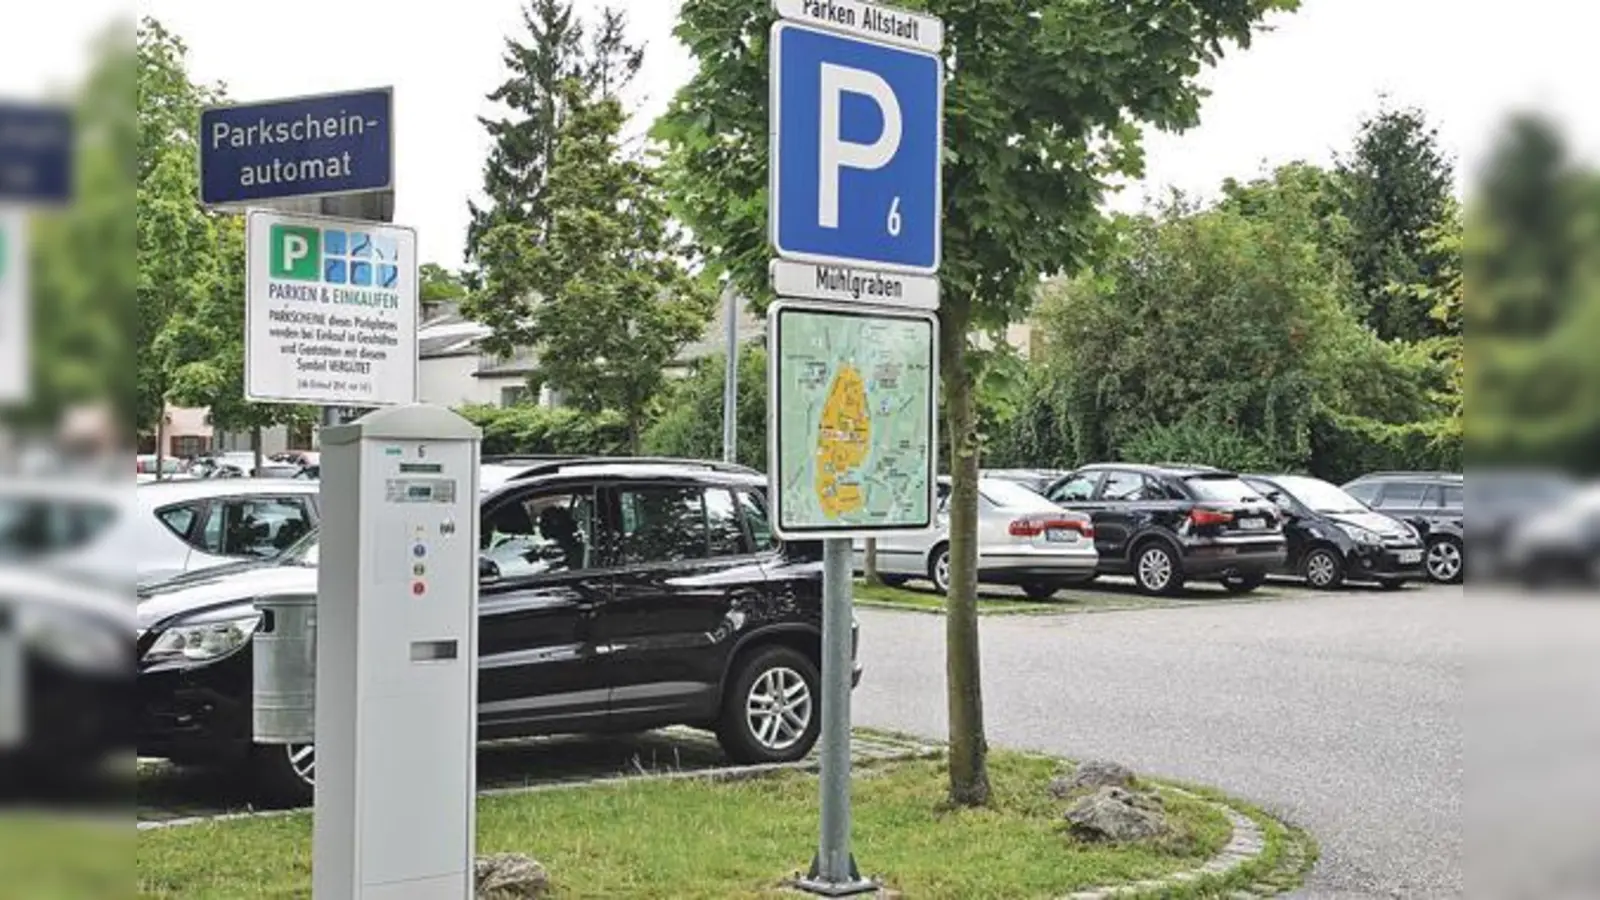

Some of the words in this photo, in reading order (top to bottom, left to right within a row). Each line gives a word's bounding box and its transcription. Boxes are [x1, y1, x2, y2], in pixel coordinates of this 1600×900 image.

[803, 0, 855, 26] Parken
[861, 7, 920, 41] Altstadt
[212, 109, 378, 149] Parkschein-
[818, 62, 903, 228] P
[240, 151, 351, 187] automat
[887, 196, 901, 236] 6
[283, 233, 309, 271] P
[269, 284, 318, 301] PARKEN
[321, 288, 330, 304] &
[333, 289, 399, 309] EINKAUFEN
[269, 310, 325, 325] PARKSCHEINE
[316, 329, 346, 342] Einkauf
